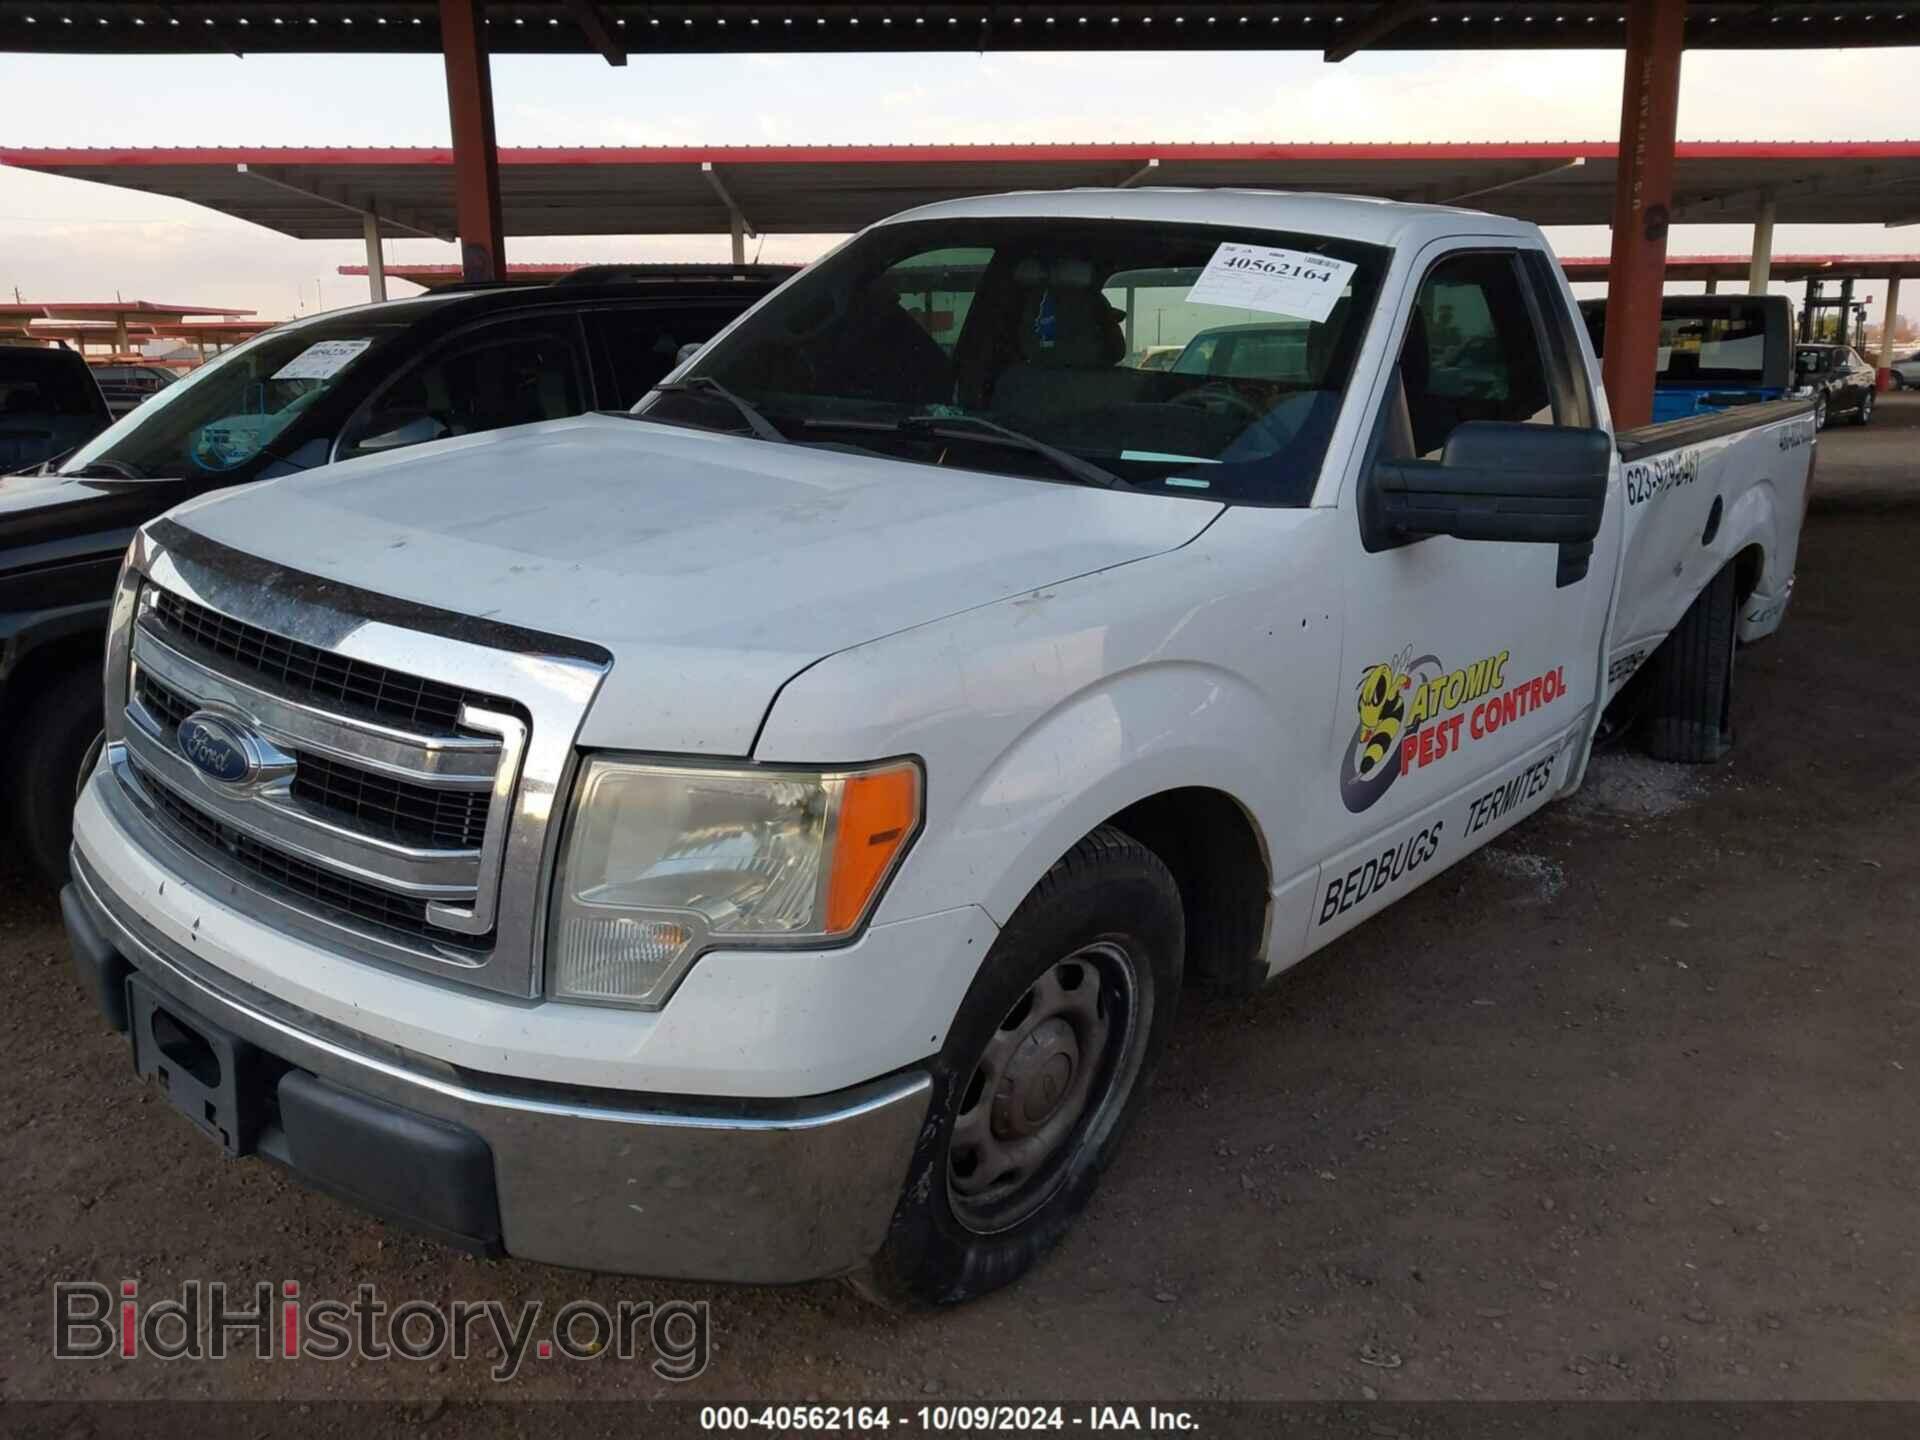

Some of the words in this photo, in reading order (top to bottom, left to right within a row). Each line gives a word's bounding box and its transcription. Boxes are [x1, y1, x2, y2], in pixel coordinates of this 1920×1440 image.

[1223, 256, 1332, 283] 40562164
[1400, 714, 1465, 777] PEST
[1470, 666, 1567, 740] CONTROL
[1404, 650, 1509, 729] ATOMIC
[187, 724, 231, 772] Ford
[1318, 820, 1444, 927] BEDBUGS
[1463, 755, 1555, 838] TERMITES
